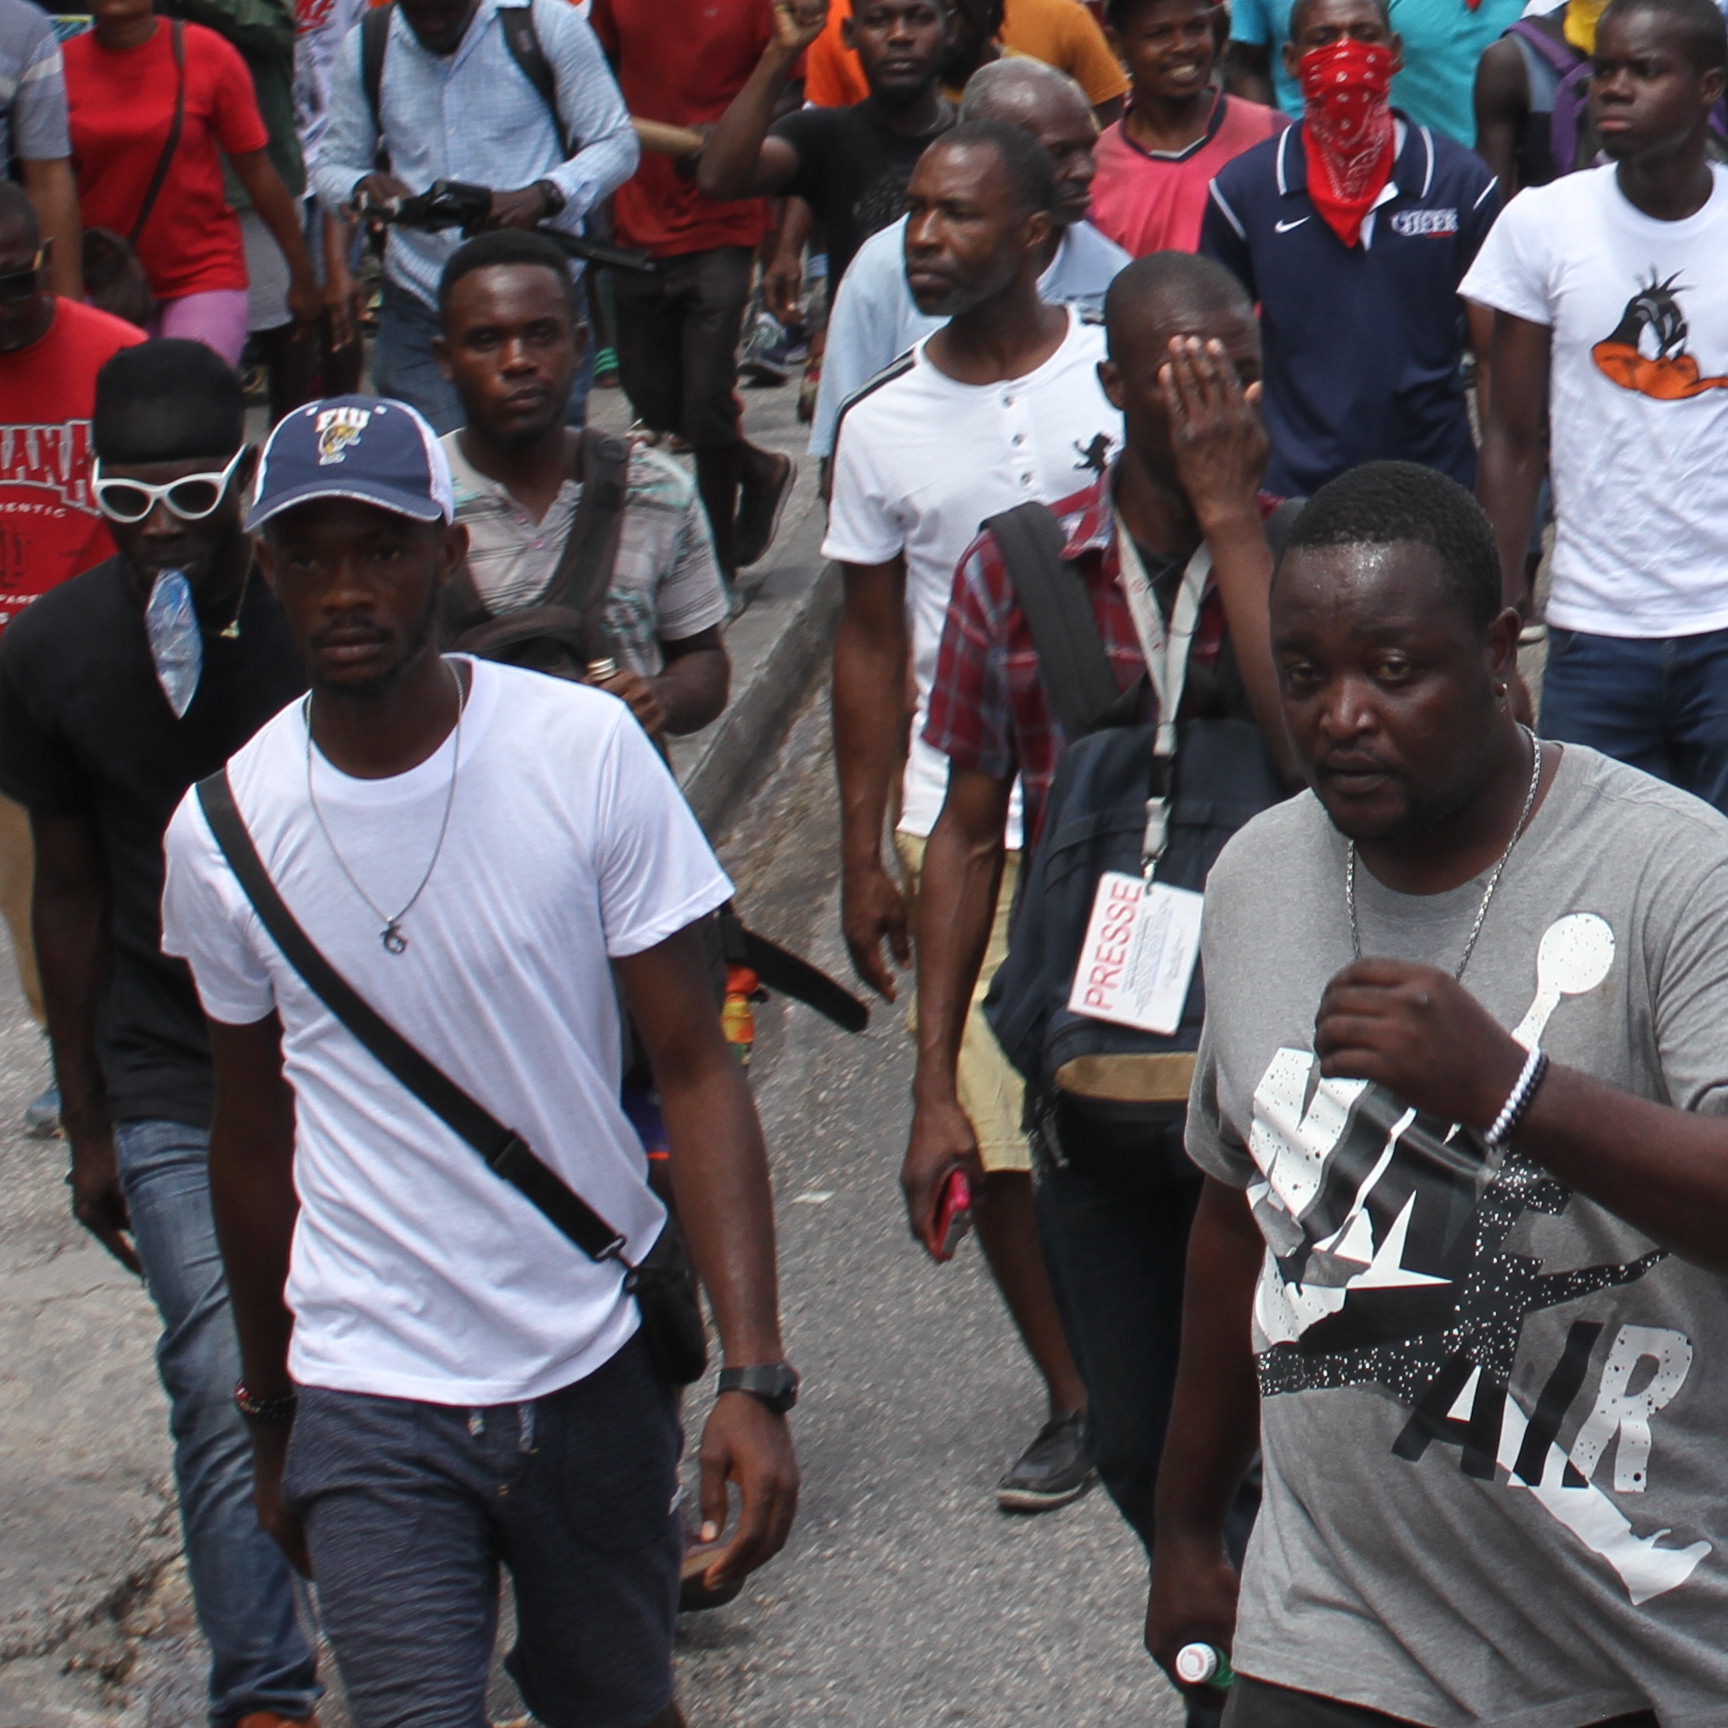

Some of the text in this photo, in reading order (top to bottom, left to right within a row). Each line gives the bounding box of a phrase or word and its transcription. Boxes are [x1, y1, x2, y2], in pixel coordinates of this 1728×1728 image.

[314, 406, 371, 433] FIU
[1083, 879, 1144, 1012] PRESSE
[1390, 1320, 1694, 1493] AIR
